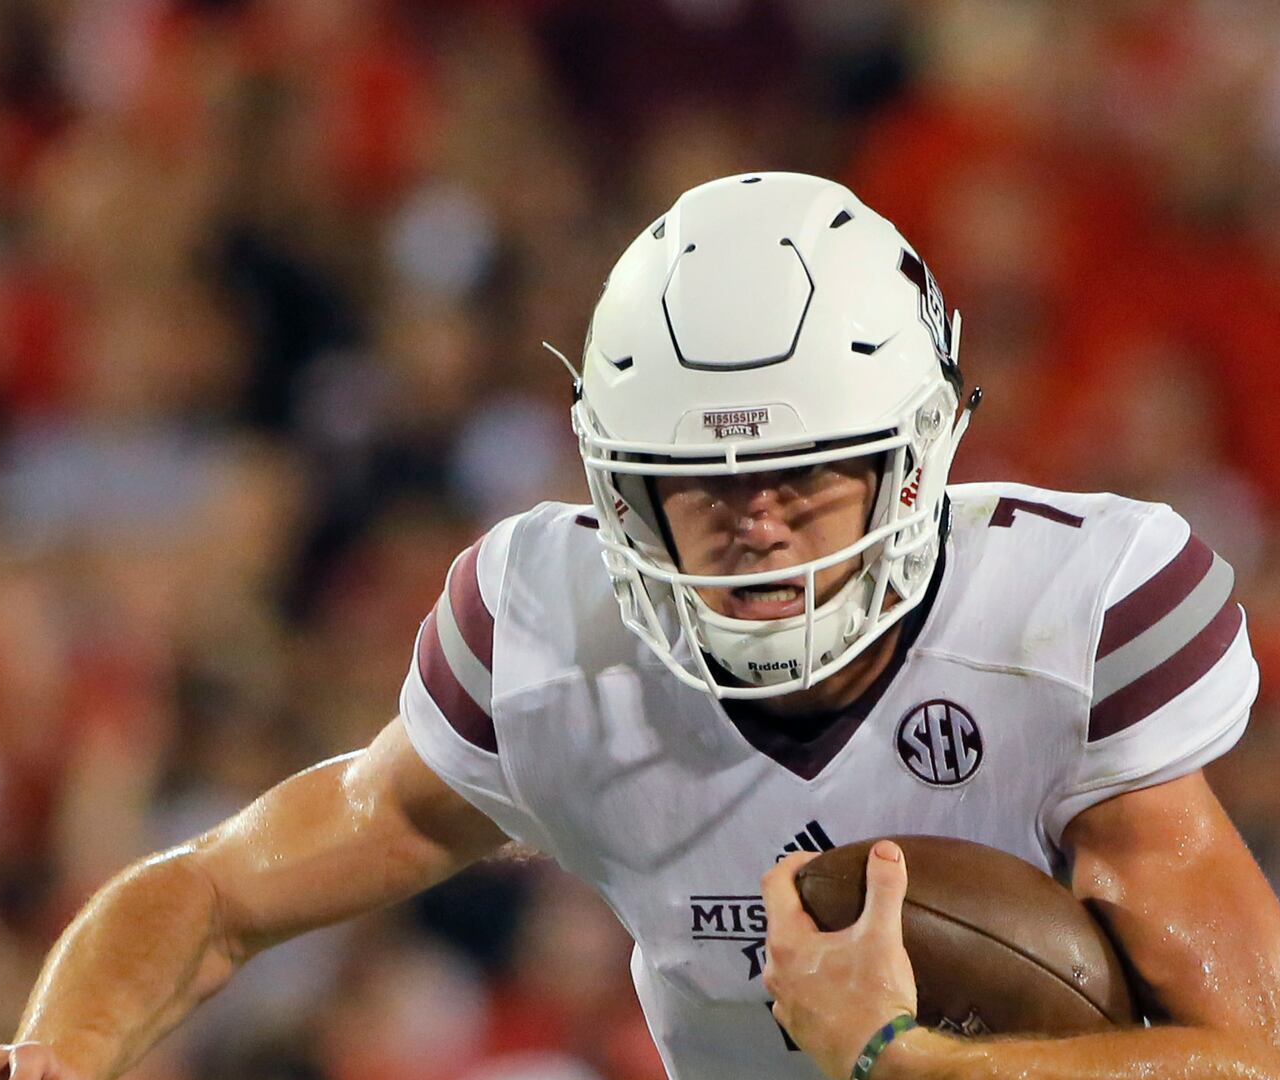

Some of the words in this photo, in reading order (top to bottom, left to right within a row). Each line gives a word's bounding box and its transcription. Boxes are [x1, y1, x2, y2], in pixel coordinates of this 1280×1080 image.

[703, 411, 768, 426] MISSISSIPPI
[721, 425, 752, 437] STATE
[748, 659, 798, 671] Riddell
[902, 704, 978, 781] SEC
